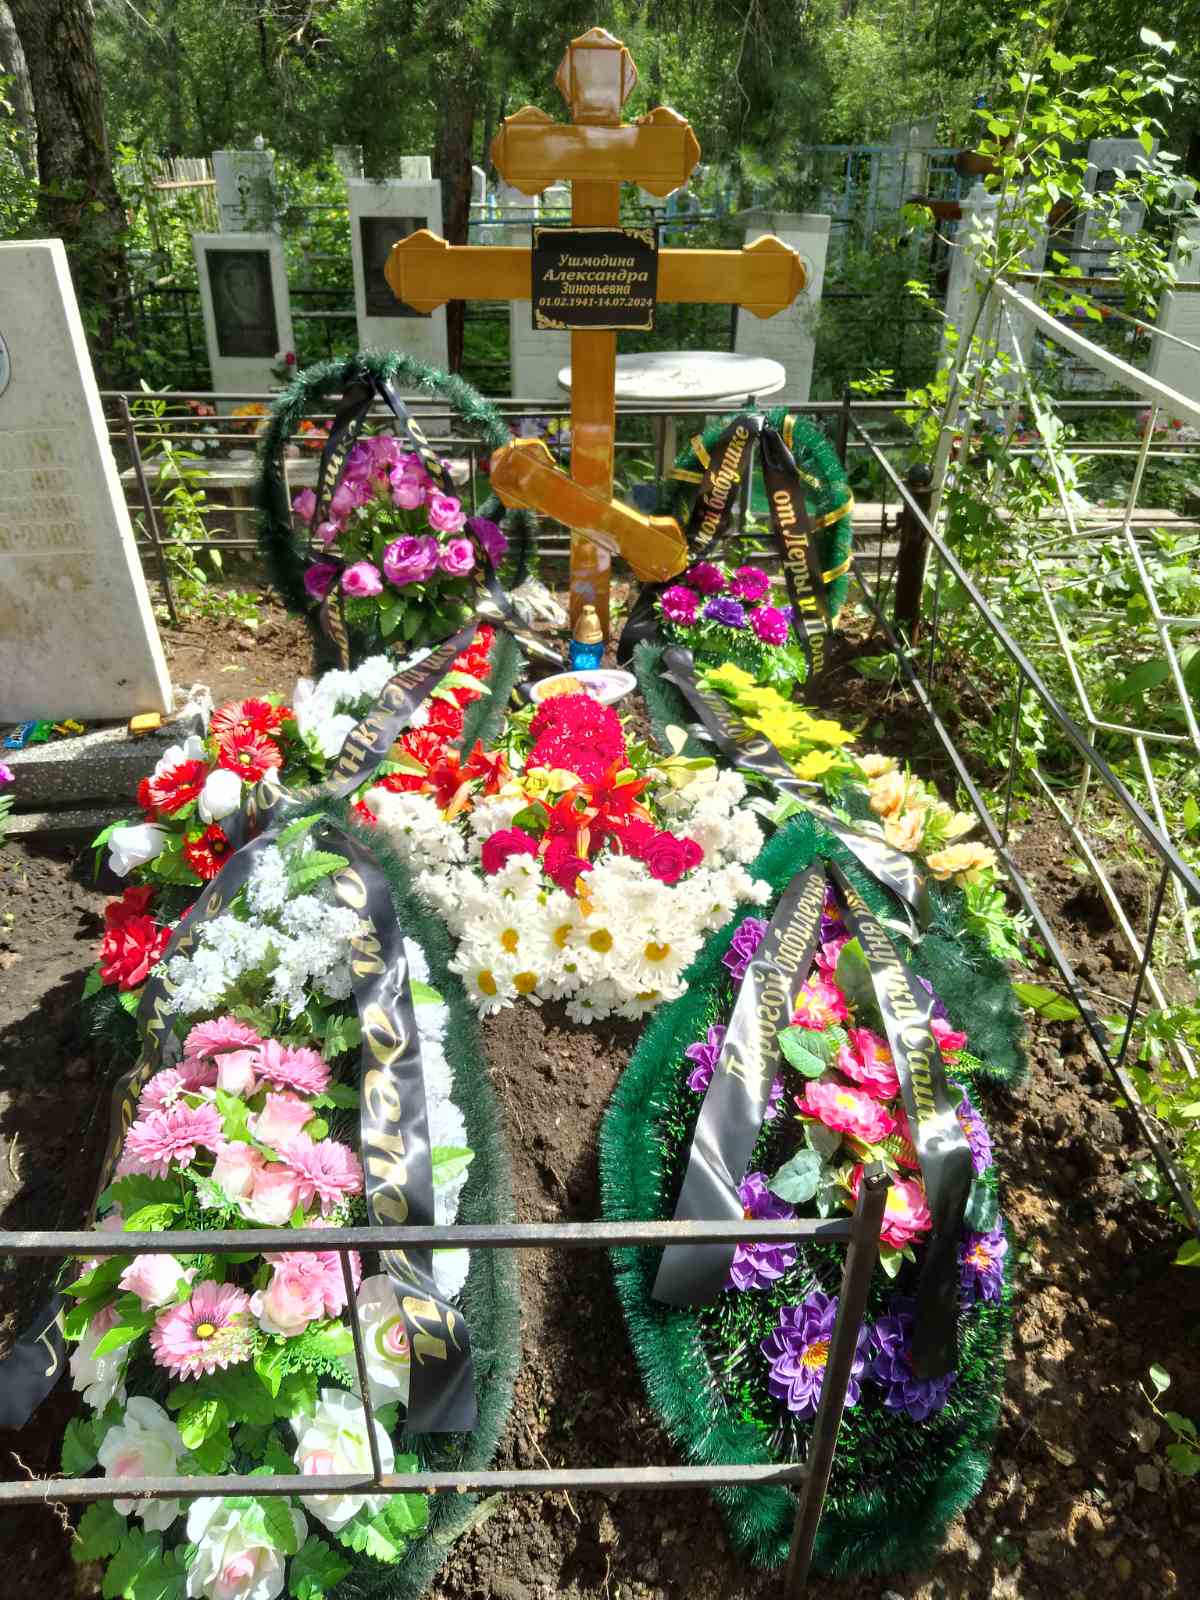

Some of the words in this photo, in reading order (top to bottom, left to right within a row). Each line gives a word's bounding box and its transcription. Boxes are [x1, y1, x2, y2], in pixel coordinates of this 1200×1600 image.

[557, 254, 636, 268] Ушмодина
[542, 268, 650, 284] Александра
[560, 281, 632, 296] Зиновьевна
[538, 297, 654, 307] 01.02.1941-14.07.2024
[704, 424, 750, 511] бабушке
[772, 489, 794, 531] от
[783, 531, 813, 594] Леры
[798, 595, 818, 613] и
